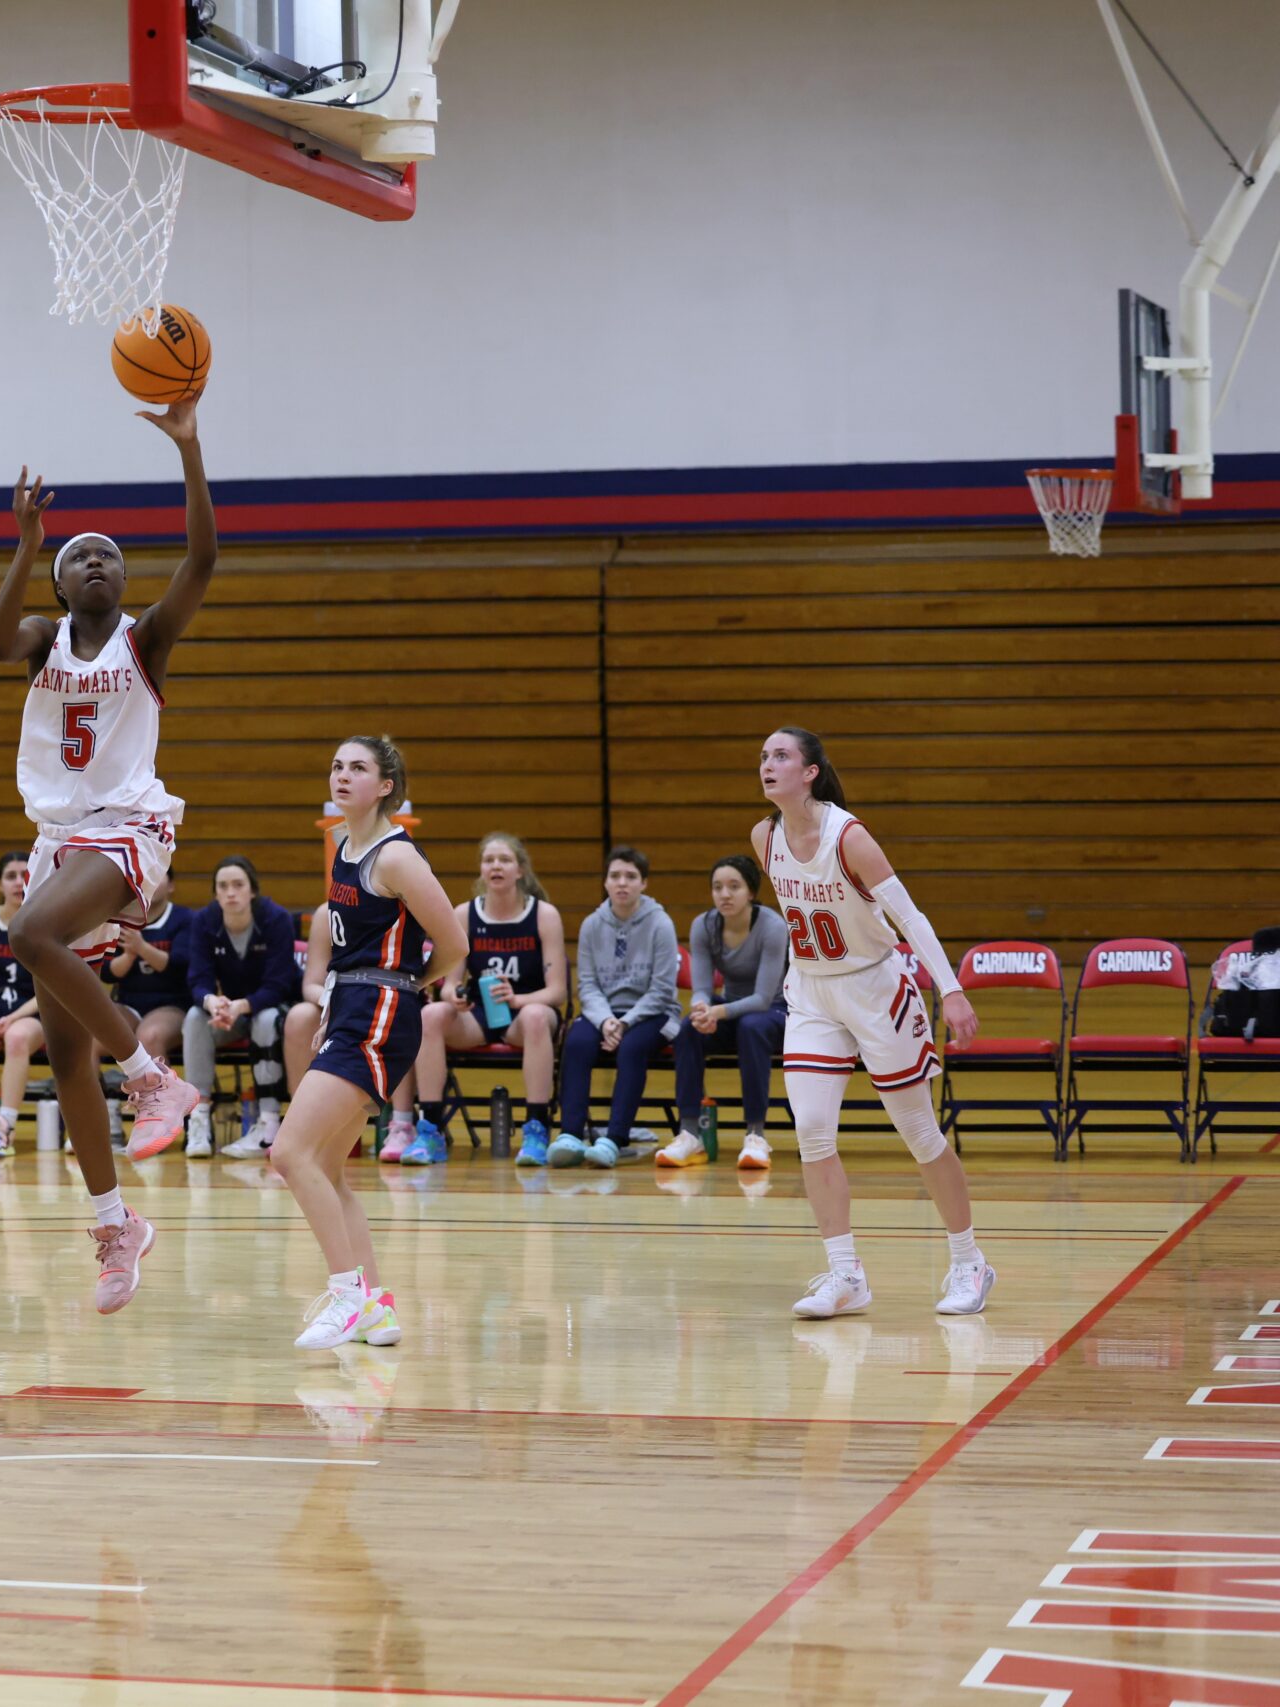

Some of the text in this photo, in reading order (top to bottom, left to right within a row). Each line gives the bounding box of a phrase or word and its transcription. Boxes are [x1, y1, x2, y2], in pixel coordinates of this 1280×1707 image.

[78, 667, 132, 694] MARY'S
[60, 702, 98, 772] 5
[803, 881, 845, 903] MARY'S
[785, 905, 849, 961] 20
[487, 955, 521, 982] 34
[972, 951, 1047, 974] CARDINALS
[1097, 950, 1173, 973] CARDINALS
